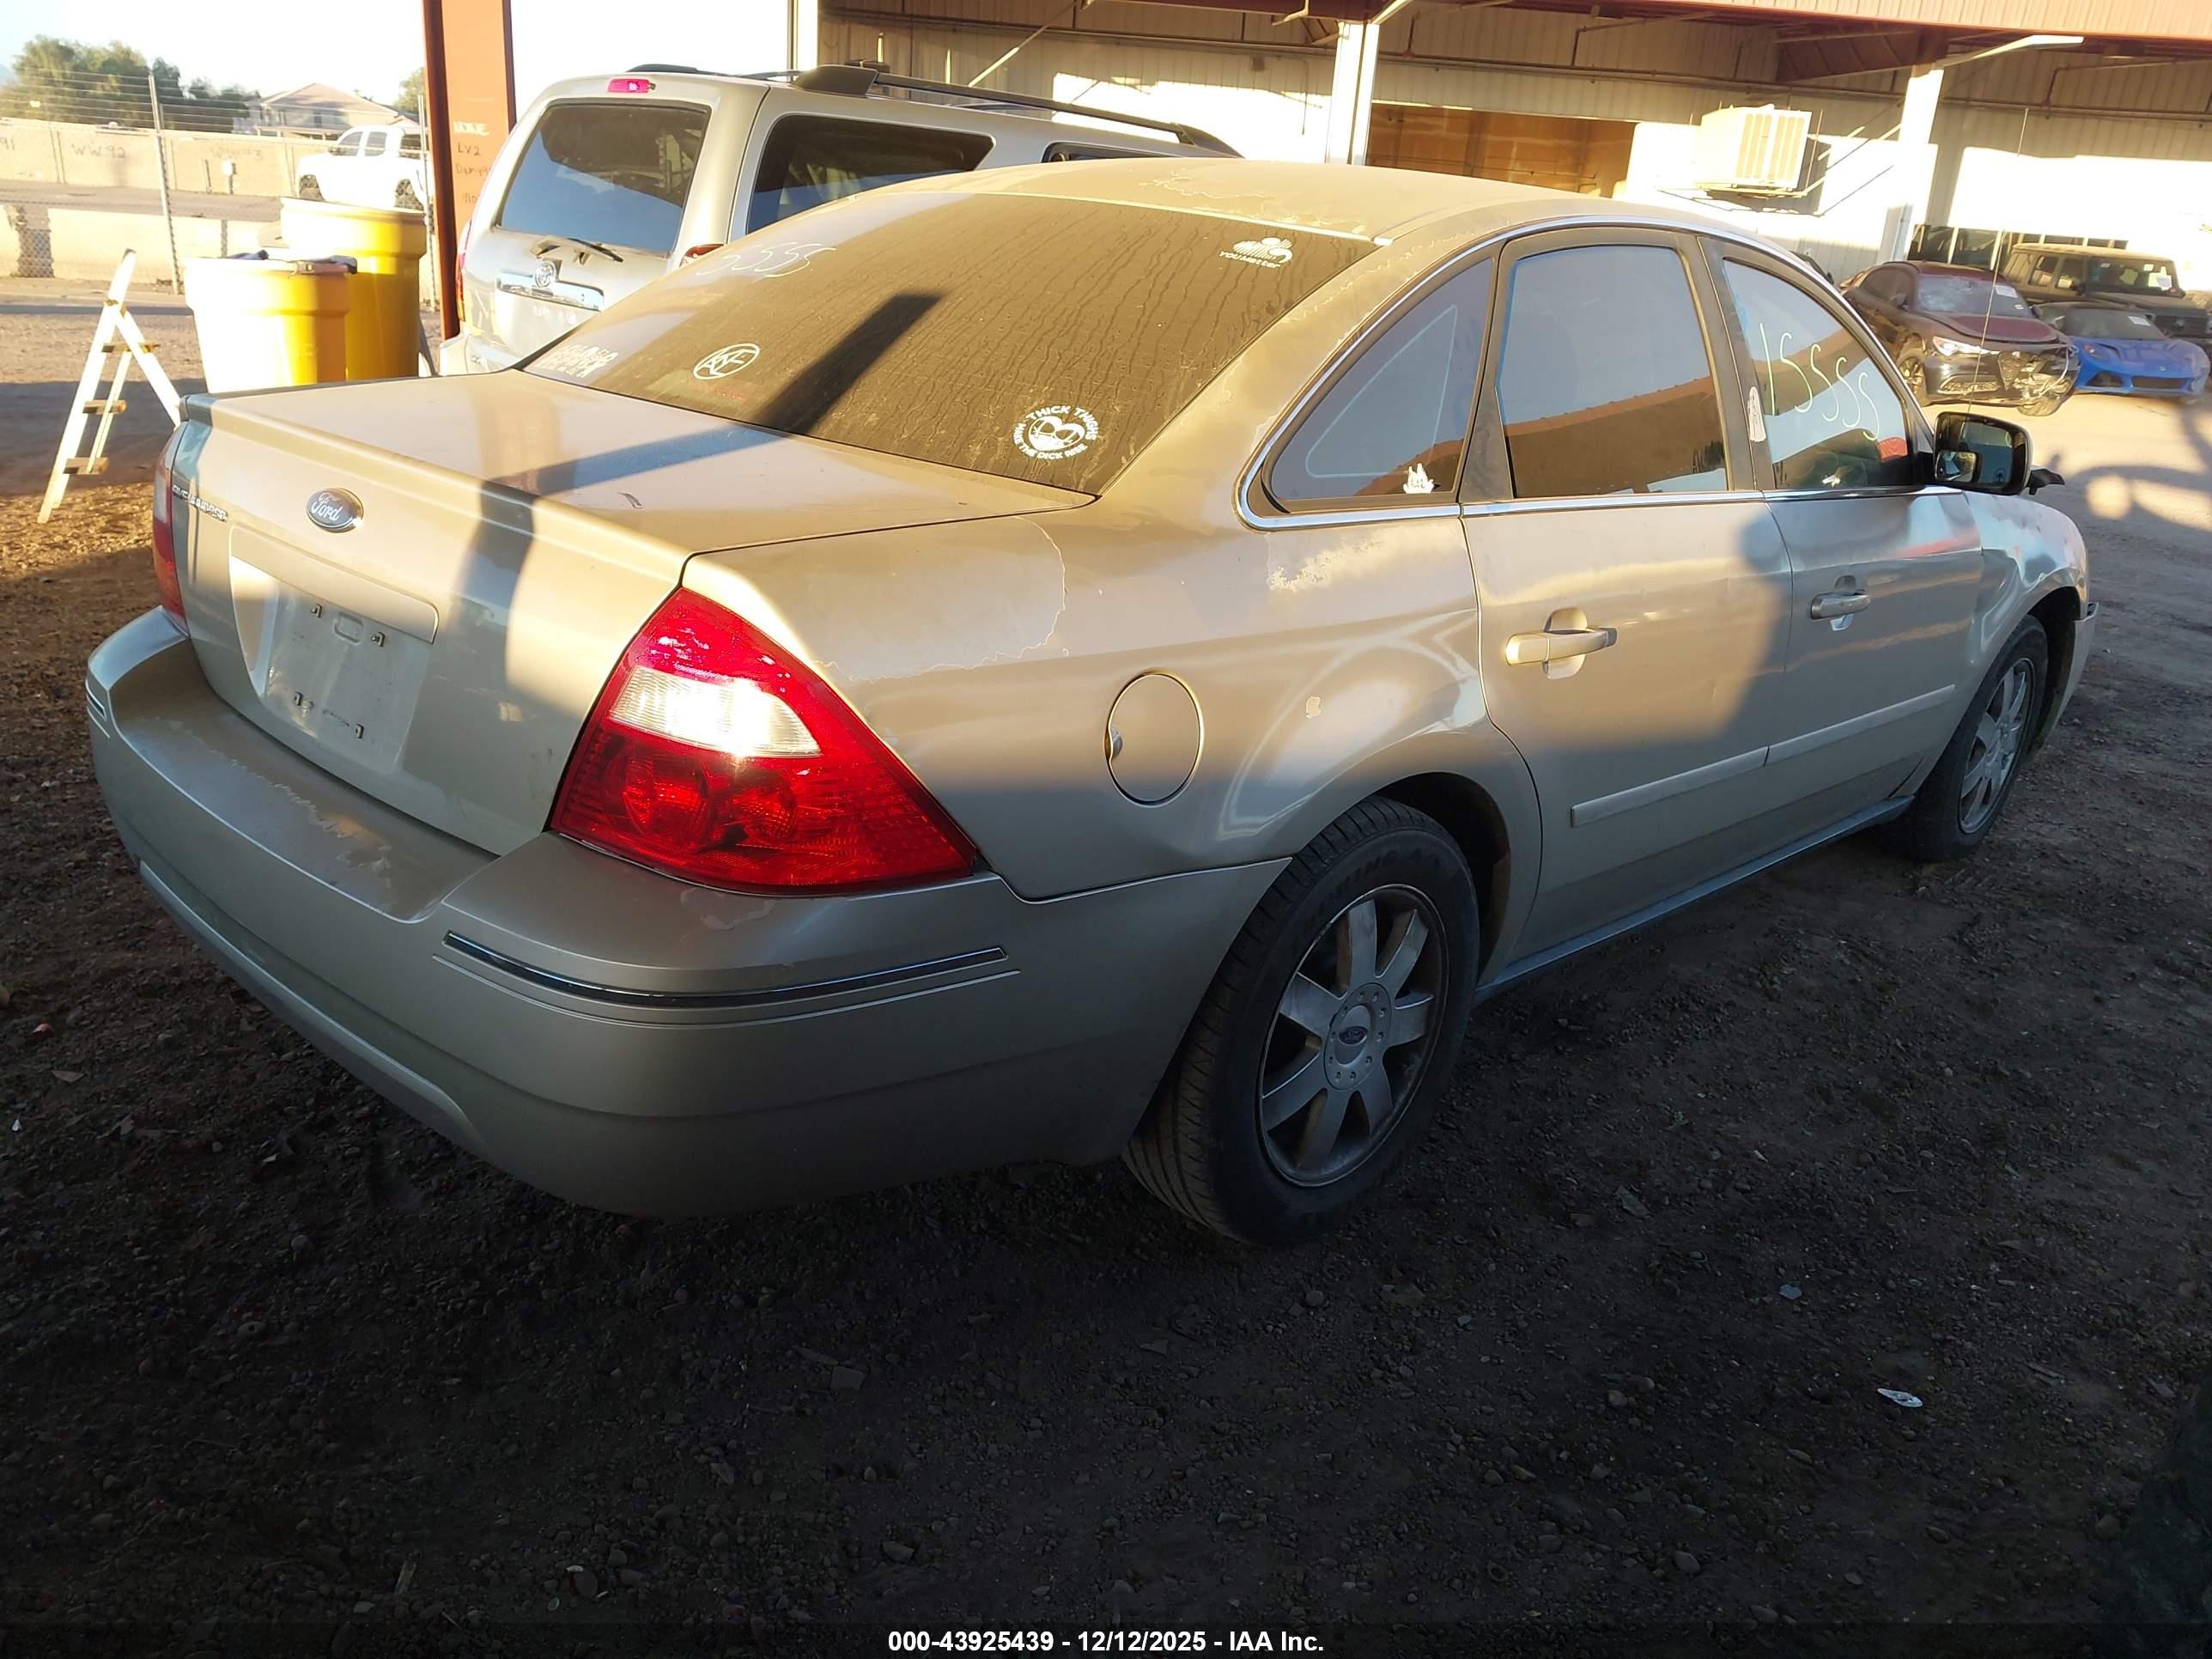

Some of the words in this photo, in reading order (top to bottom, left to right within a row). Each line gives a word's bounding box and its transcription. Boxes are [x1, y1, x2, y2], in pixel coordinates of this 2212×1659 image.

[1025, 404, 1072, 420] THICK
[1073, 406, 1099, 441] THIGHS
[310, 492, 343, 522] Ford
